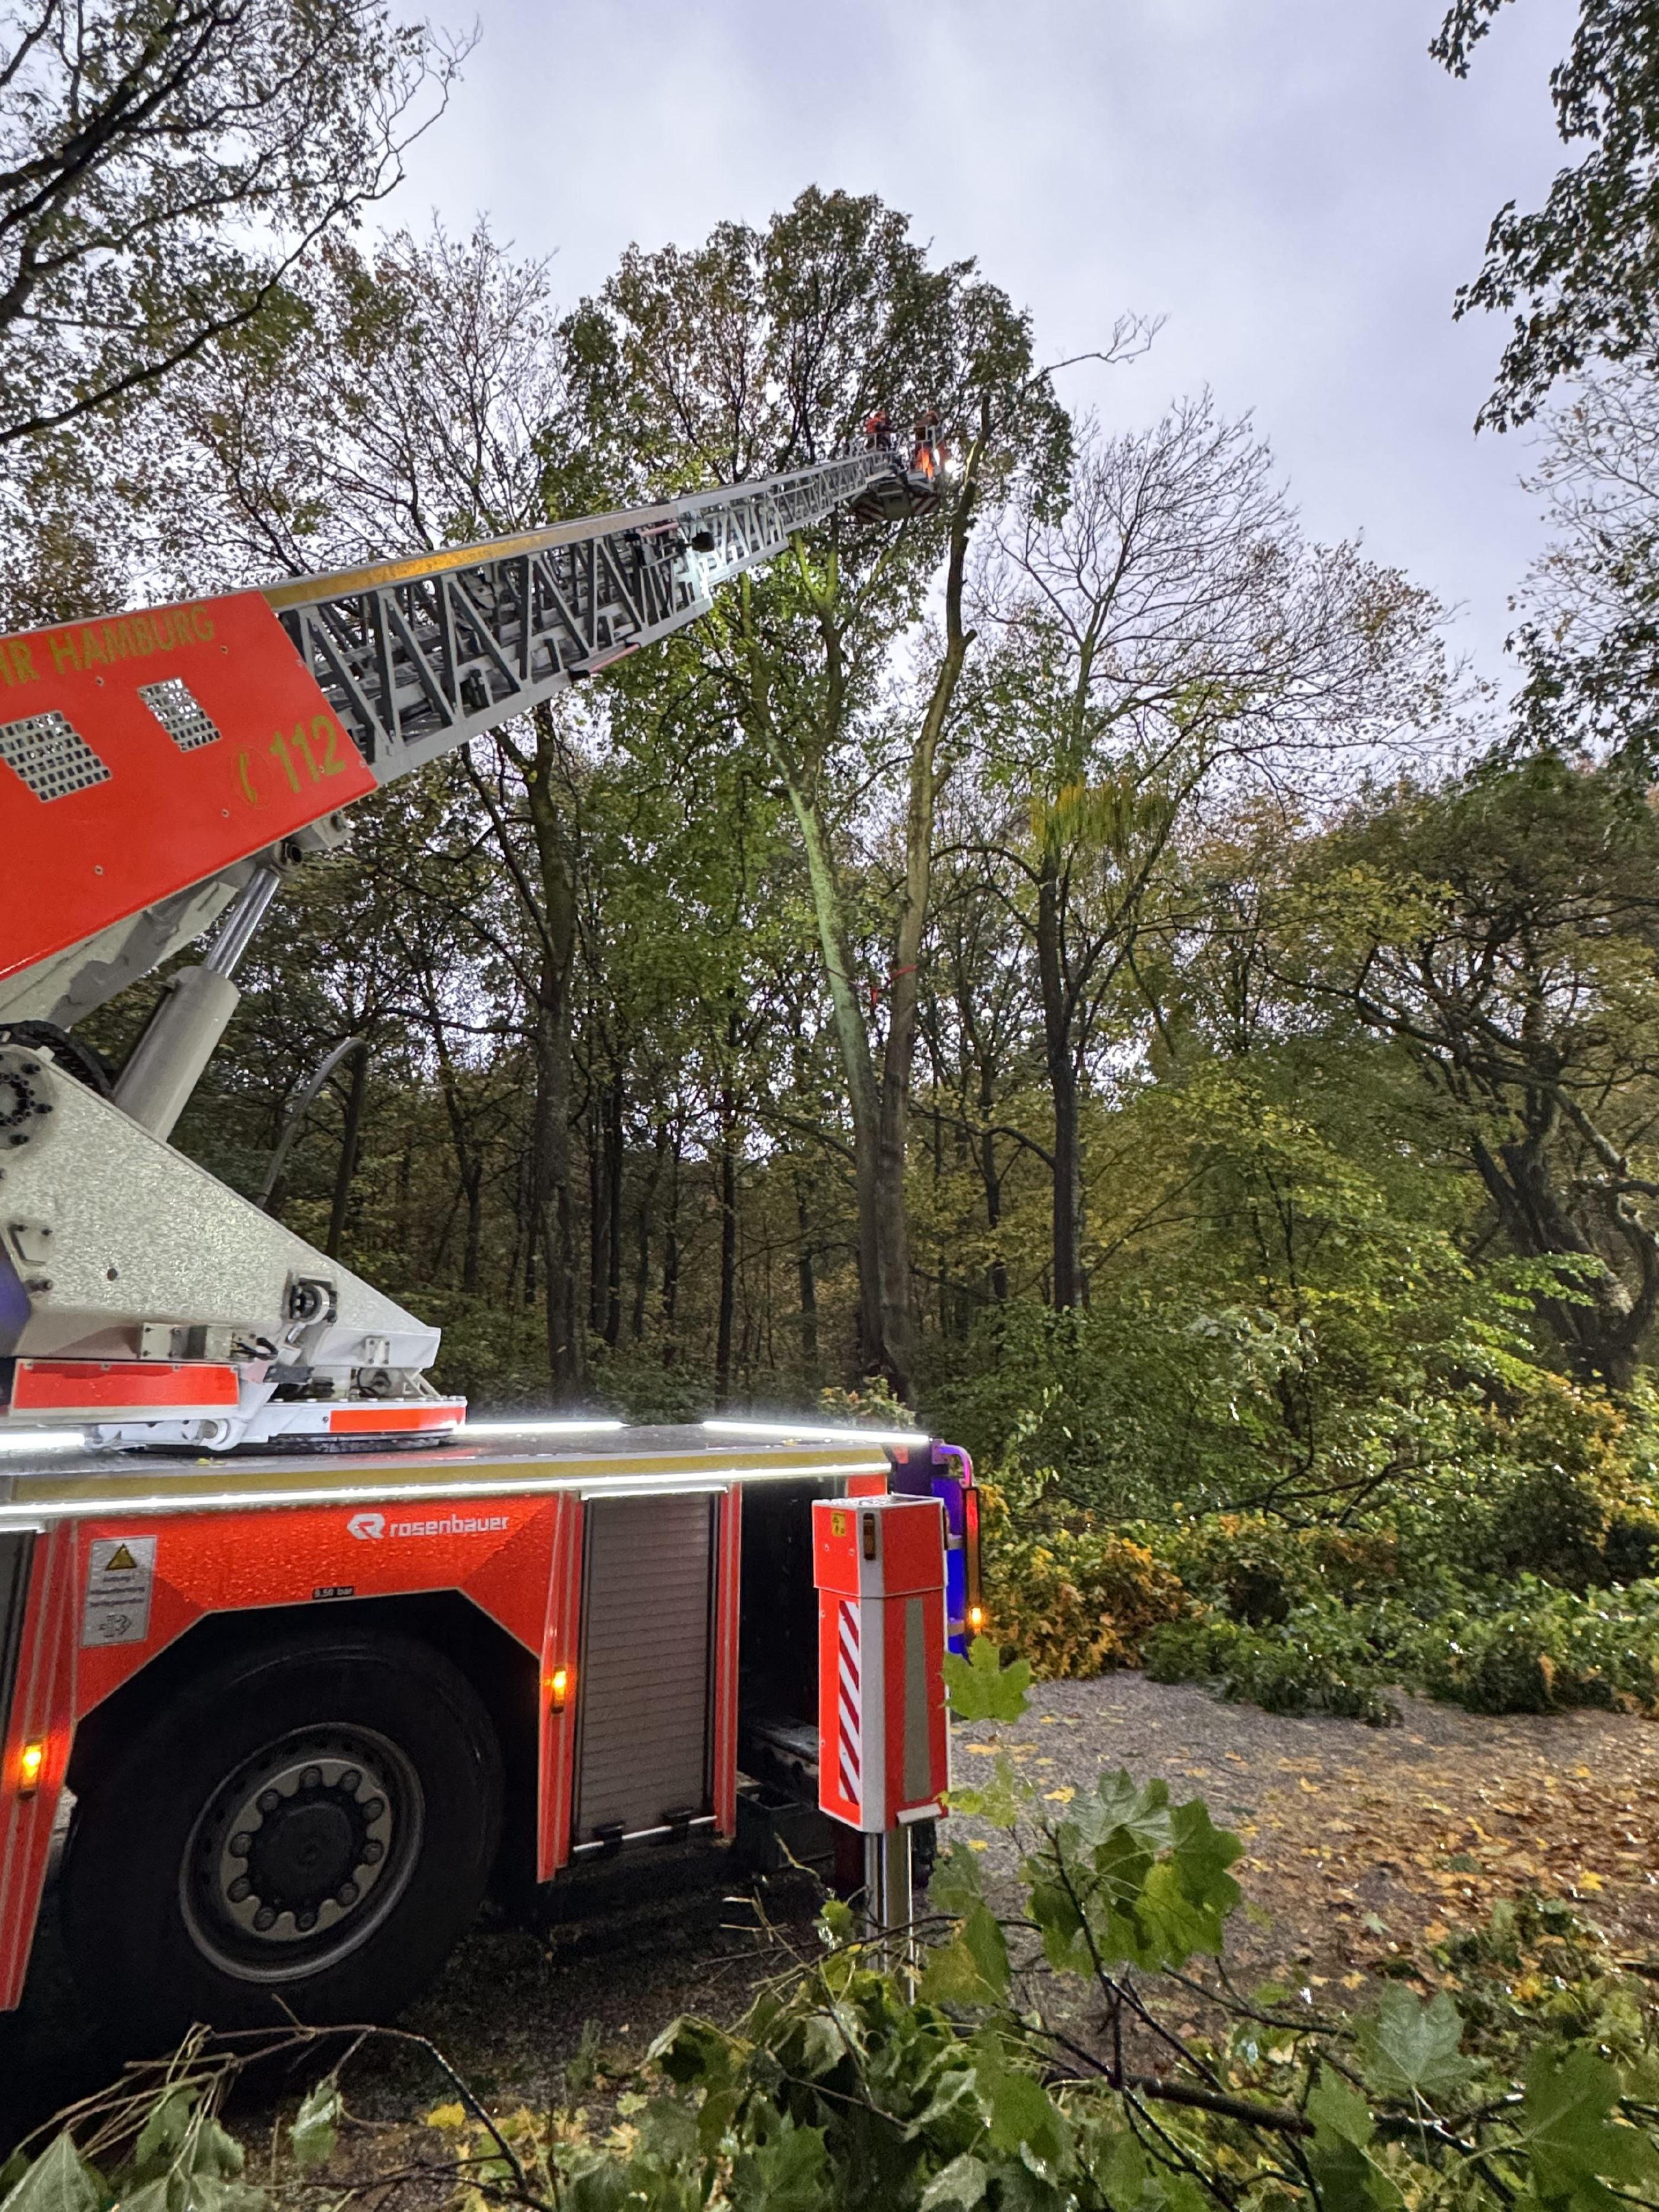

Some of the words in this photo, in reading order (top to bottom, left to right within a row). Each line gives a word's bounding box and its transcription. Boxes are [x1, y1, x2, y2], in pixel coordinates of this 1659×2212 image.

[47, 604, 214, 675] HAMBURG
[270, 715, 346, 794] 112
[389, 1514, 510, 1538] rosenbauer
